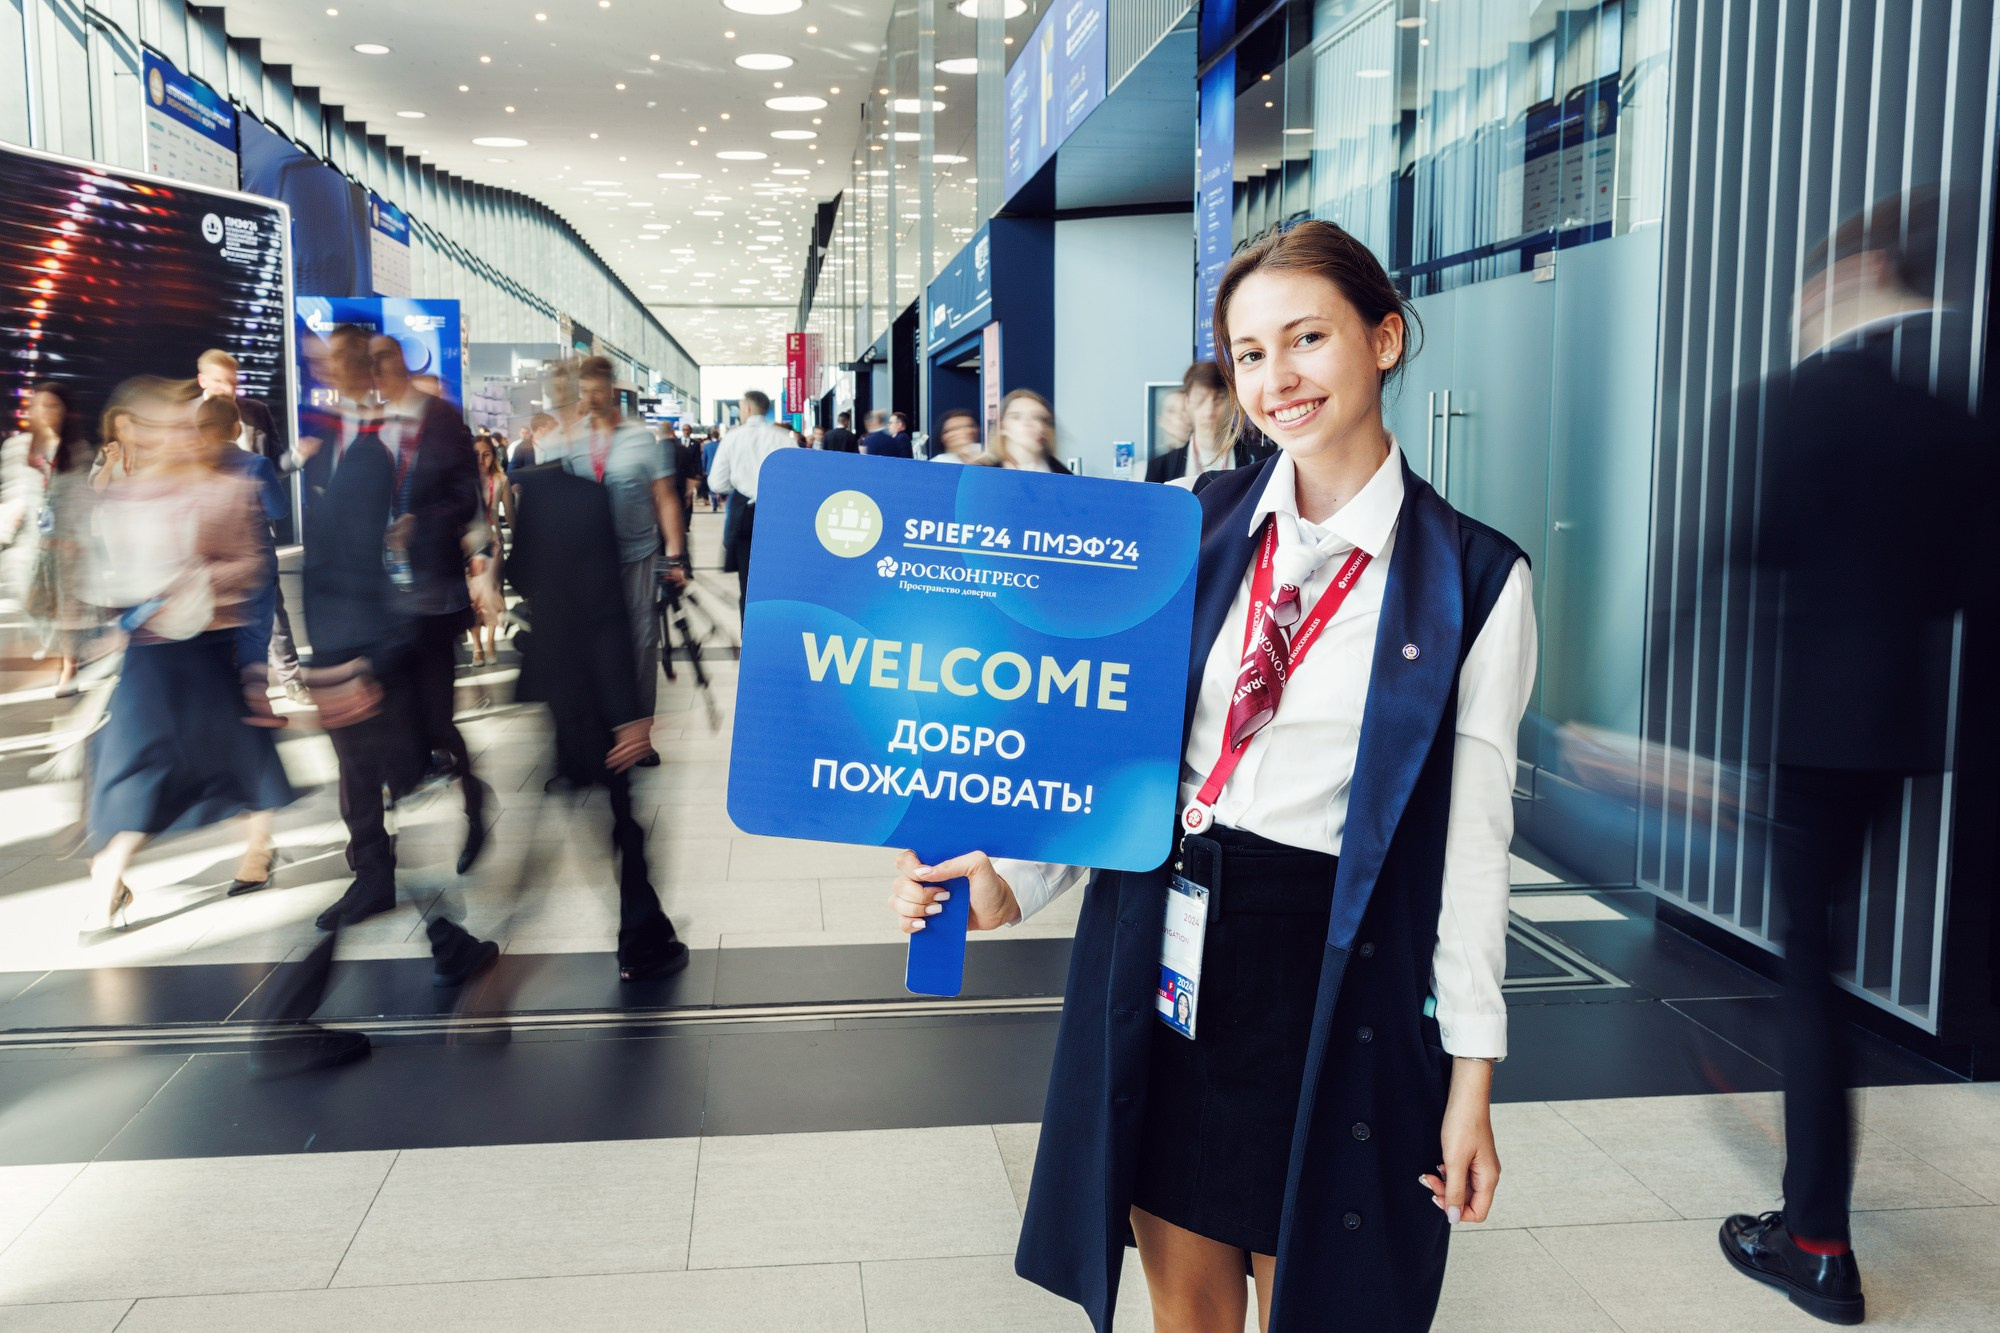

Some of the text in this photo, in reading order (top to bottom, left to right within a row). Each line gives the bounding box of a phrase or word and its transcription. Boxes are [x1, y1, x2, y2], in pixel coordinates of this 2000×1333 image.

[790, 335, 800, 351] E
[789, 360, 797, 378] HALL
[904, 518, 1140, 562] SPIEF'24 ПМЭФ'24
[900, 561, 1040, 589] РОСКОНГРЕСС
[899, 580, 997, 599] Пространство доверия
[1290, 618, 1321, 659] ROSCONGRESS
[802, 631, 1130, 712] WELCOME
[888, 719, 1026, 760] ДОБРО
[811, 758, 1094, 814] ПОЖАЛОВАТЬ!
[1183, 913, 1200, 927] 2024
[1177, 977, 1194, 992] 2024
